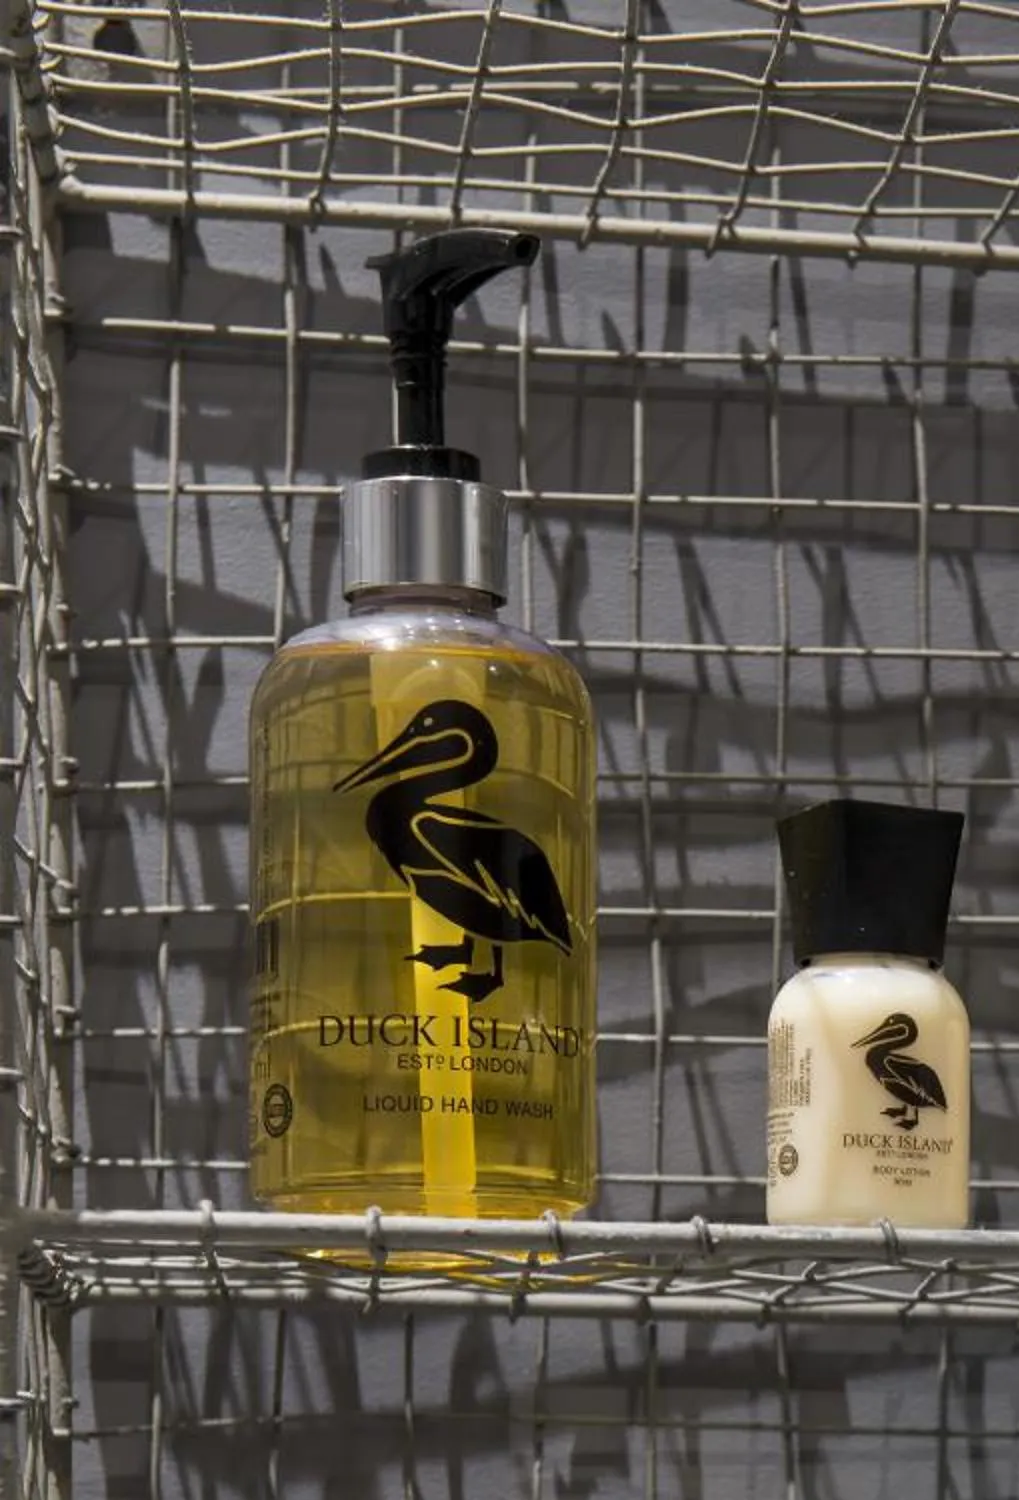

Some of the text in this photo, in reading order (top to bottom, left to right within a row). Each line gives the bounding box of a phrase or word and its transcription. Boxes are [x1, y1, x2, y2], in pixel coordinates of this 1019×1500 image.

[318, 1014, 438, 1048] DUCK
[452, 1015, 580, 1057] ISLAND
[449, 1055, 528, 1076] LONDON
[363, 1095, 554, 1121] LIQUID HAND WASH
[842, 1133, 951, 1154] DUCK ISLAND
